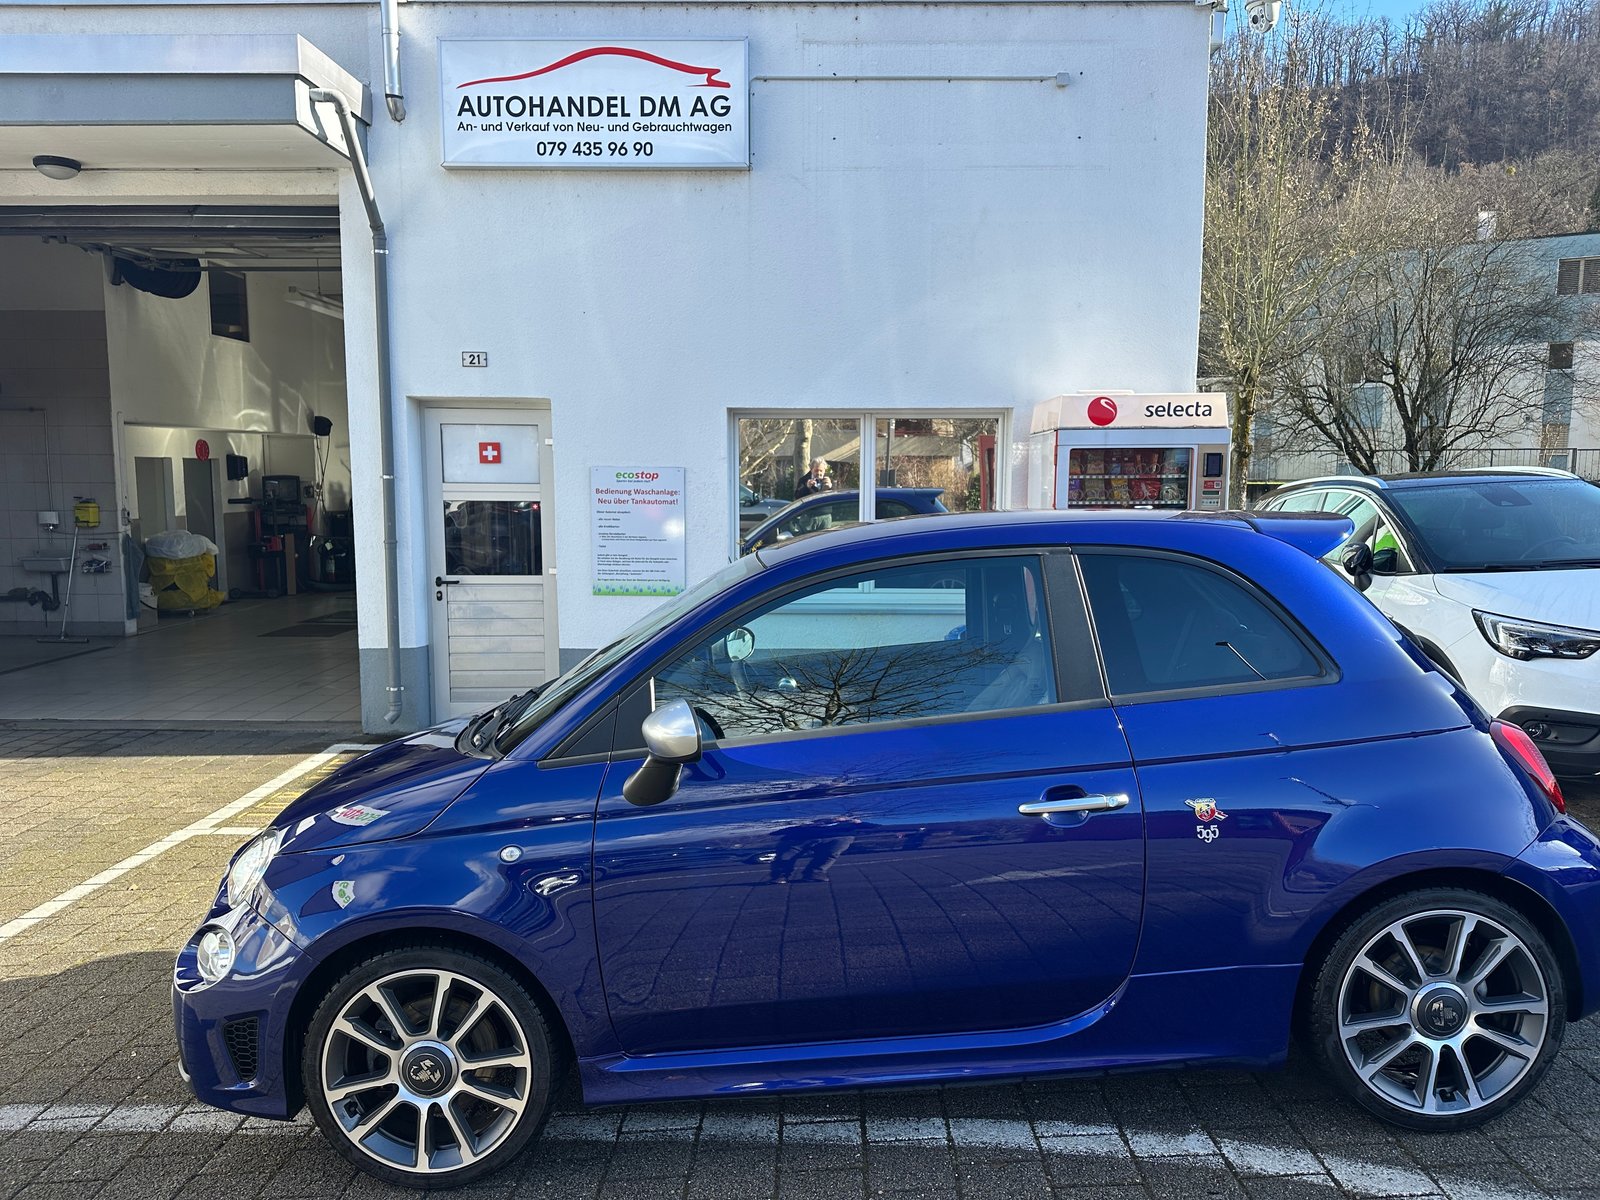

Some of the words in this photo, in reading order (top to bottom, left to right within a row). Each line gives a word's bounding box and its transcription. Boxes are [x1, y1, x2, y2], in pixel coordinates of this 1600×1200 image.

[457, 95, 631, 118] AUTOHANDEL
[640, 95, 682, 117] DM
[690, 95, 732, 118] AG
[457, 122, 478, 132] An-
[481, 122, 502, 132] und
[506, 122, 550, 132] Verkauf
[553, 124, 574, 132] von
[577, 122, 604, 132] Neu-
[607, 122, 629, 132] und
[632, 122, 732, 134] Gebrauchtwagen
[536, 142, 567, 156] 079
[572, 142, 602, 156] 435
[608, 142, 628, 156] 96
[633, 142, 653, 156] 90
[469, 354, 481, 365] 21
[1144, 401, 1212, 418] selecta
[615, 470, 659, 481] ecostop
[595, 488, 632, 496] Bedienung
[633, 488, 681, 497] Waschanlage:
[1196, 825, 1219, 843] 595
